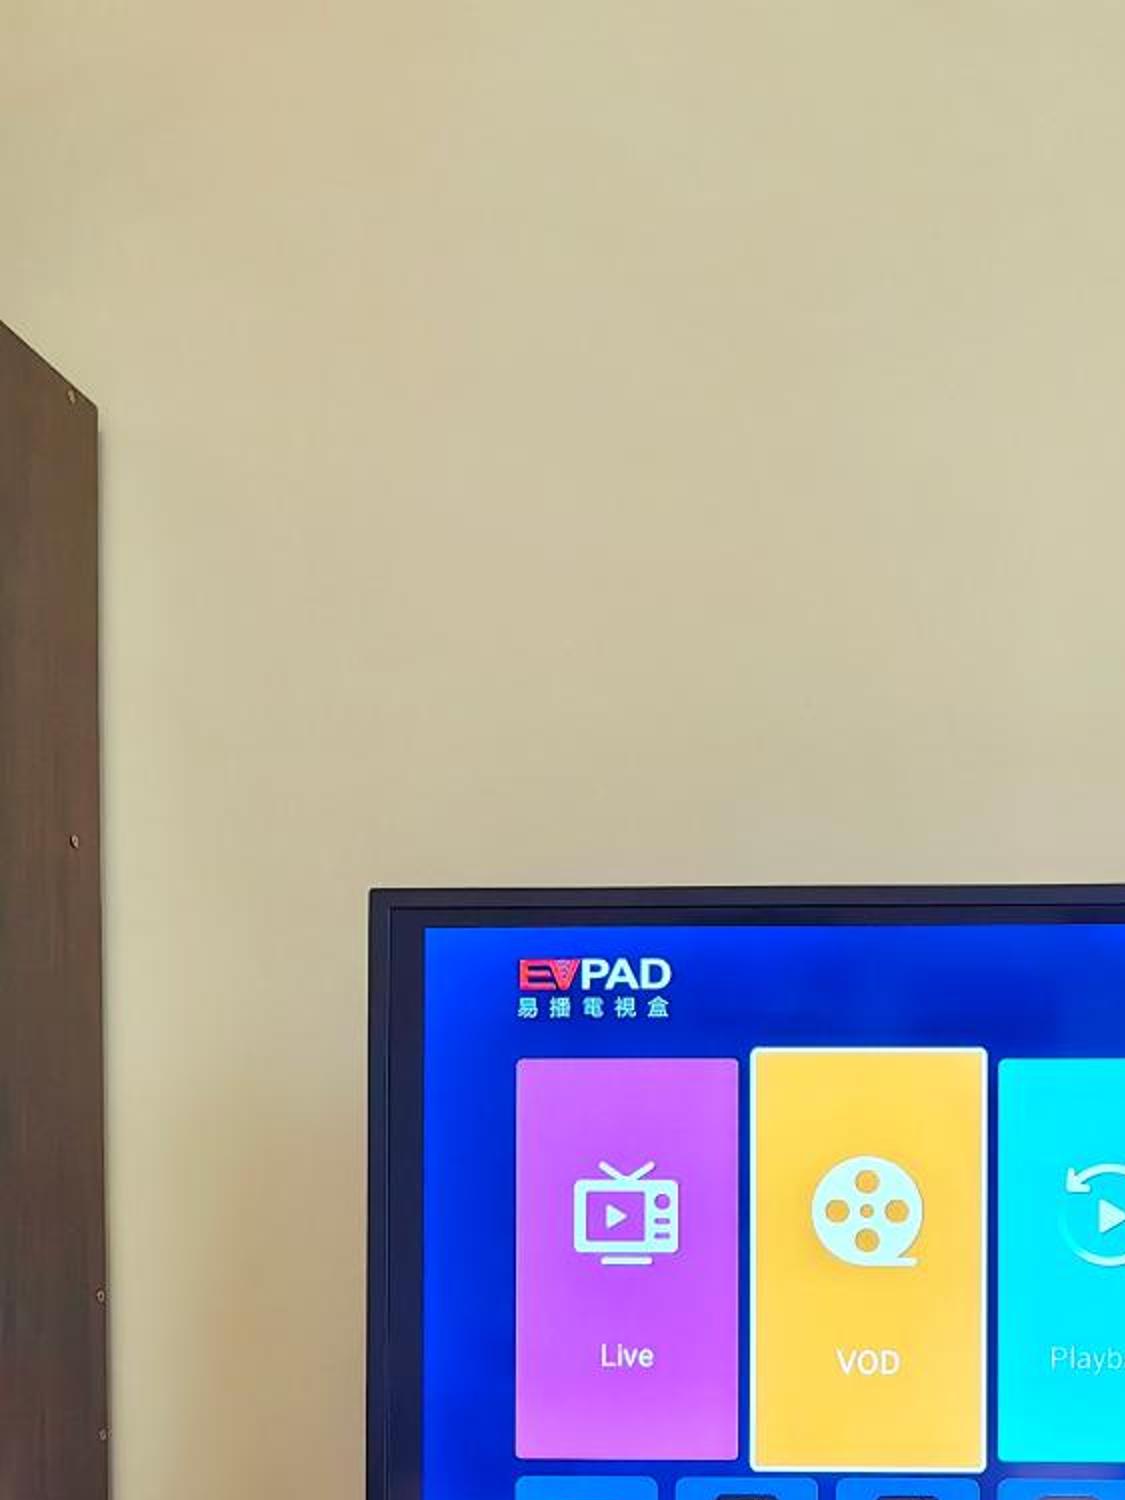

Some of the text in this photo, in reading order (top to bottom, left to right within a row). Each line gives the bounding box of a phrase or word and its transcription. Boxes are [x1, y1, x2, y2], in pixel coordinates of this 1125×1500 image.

[519, 957, 672, 991] EVPAD
[517, 996, 670, 1019] 易播電視盒
[600, 1343, 655, 1369] Live
[836, 1349, 902, 1376] VOD
